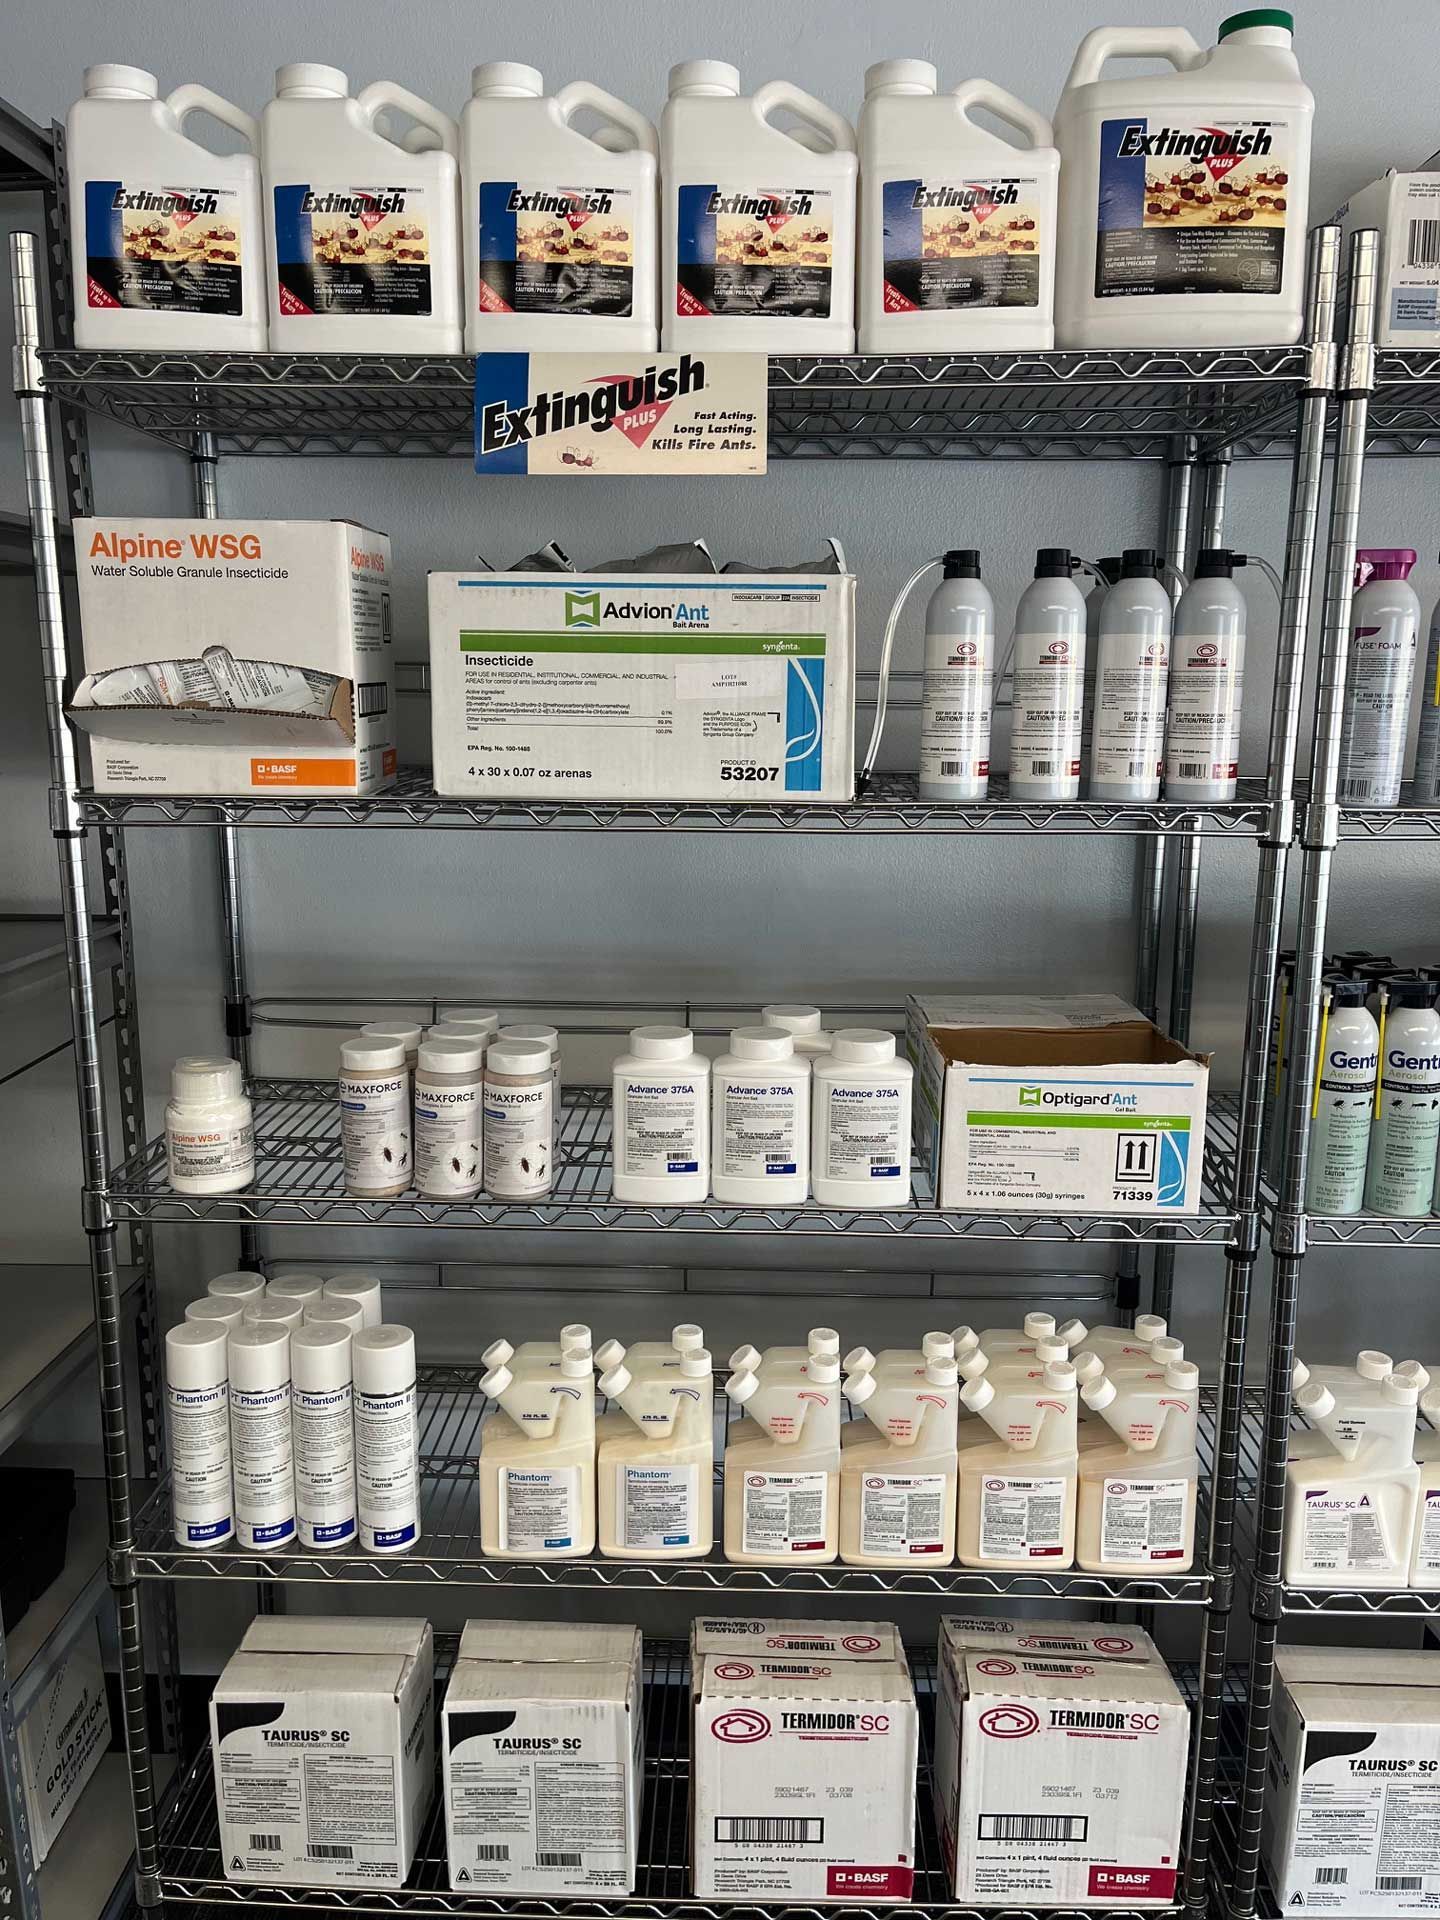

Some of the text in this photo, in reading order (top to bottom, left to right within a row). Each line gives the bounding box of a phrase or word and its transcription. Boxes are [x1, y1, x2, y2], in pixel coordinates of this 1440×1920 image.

[1117, 125, 1272, 164] Extinguish
[1210, 158, 1233, 168] PLUS
[112, 188, 218, 217] Extinguish
[506, 189, 612, 218] Extinguish
[912, 184, 1018, 212] Extinguish
[300, 192, 405, 218] Extinguish
[706, 192, 812, 221] Extinguish
[175, 214, 192, 222] PLUS
[363, 214, 380, 222] PLUS
[569, 214, 586, 222] PLUS
[481, 354, 705, 455] Extinguish
[623, 409, 657, 430] PLUS
[694, 411, 757, 421] Fast Acting.
[674, 424, 757, 435] Long Lasting.
[652, 439, 756, 450] Kills Fire Ants.
[90, 532, 261, 563] Alpine WSG
[91, 565, 288, 579] Water Soluble Granule Insecticide
[603, 602, 710, 620] Advion Ant
[763, 641, 798, 652] syngenta
[466, 655, 534, 666] Insecticide
[271, 765, 297, 774] BASF
[468, 768, 475, 776] 4
[488, 768, 501, 776] 30
[513, 768, 535, 777] 0.07
[539, 770, 551, 778] oz
[554, 770, 592, 778] arenas
[720, 767, 779, 781] 53207
[1329, 1070, 1366, 1080] Aerosol
[1388, 1070, 1427, 1080] Aerosol
[347, 1081, 402, 1094] MAXFORCE
[628, 1085, 694, 1094] Advance 375A
[727, 1085, 793, 1095] Advance 375A
[832, 1088, 898, 1098] Advance 375A
[421, 1092, 476, 1103] MAXFORCE
[490, 1092, 543, 1103] MAXFORCE
[1043, 1091, 1137, 1108] Optigard Ant
[1144, 1120, 1171, 1129] syngenta
[171, 1133, 221, 1143] Alpine WSG
[1384, 1170, 1405, 1178] CAUTION
[1055, 1192, 1085, 1200] syringes
[1113, 1191, 1153, 1201] 71339
[176, 1392, 218, 1403] Phantom
[241, 1393, 283, 1405] Phantom
[302, 1394, 343, 1406] Phantom
[363, 1398, 403, 1410] Phantom
[508, 1473, 550, 1482] Phantom
[627, 1470, 669, 1478] Phantom
[265, 1528, 282, 1536] BASF
[767, 1639, 836, 1650] TERMIDOR SC
[1018, 1639, 1088, 1650] TERMIDOR SC
[760, 1665, 832, 1675] TERMIDOR SC
[1022, 1662, 1094, 1674] TERMIDOR SC
[781, 1713, 889, 1731] TERMIDOR SC
[1050, 1710, 1159, 1730] TERMIDOR SC
[331, 1731, 350, 1742] SC
[46, 1692, 102, 1794] GOLD STICK
[562, 1739, 581, 1749] SC
[1418, 1760, 1437, 1772] SC
[854, 1873, 888, 1882] BASF
[1116, 1875, 1150, 1884] BASF
